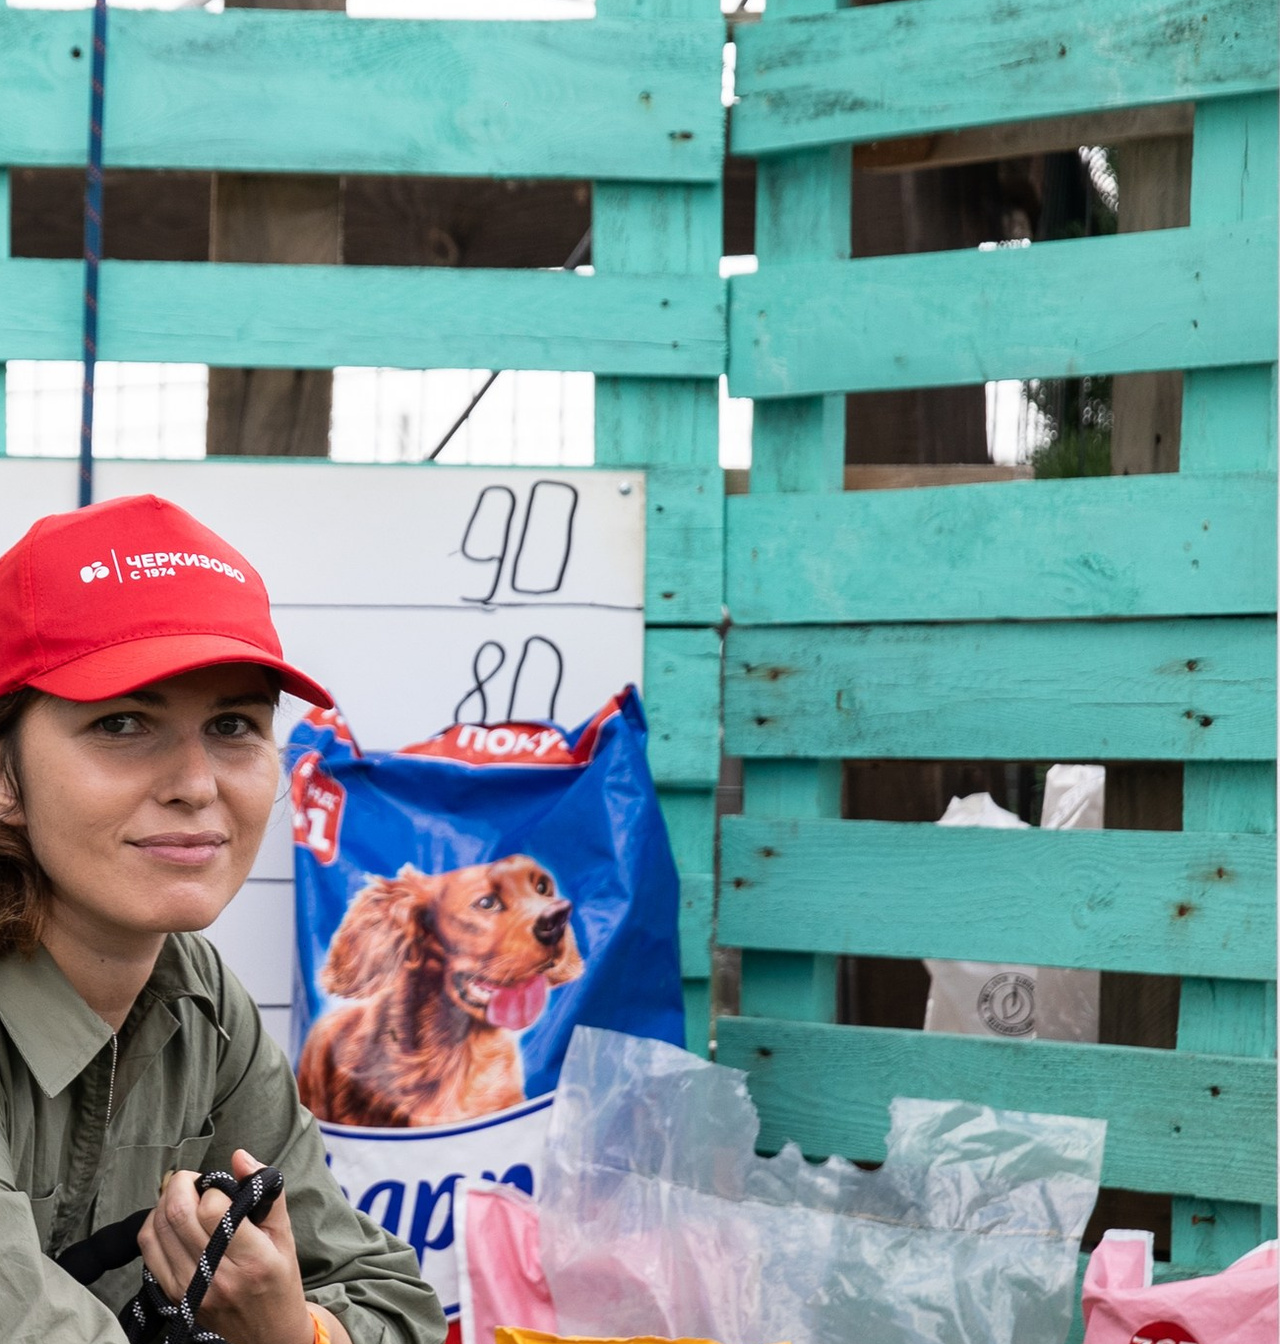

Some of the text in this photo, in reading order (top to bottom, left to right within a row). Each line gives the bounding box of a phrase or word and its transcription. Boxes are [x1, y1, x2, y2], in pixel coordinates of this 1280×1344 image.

[460, 479, 578, 604] 90
[126, 552, 246, 583] ЧЕРКИЗОВО
[144, 567, 176, 578] 1974
[454, 636, 563, 724] 80
[456, 723, 571, 757] ПОКУ
